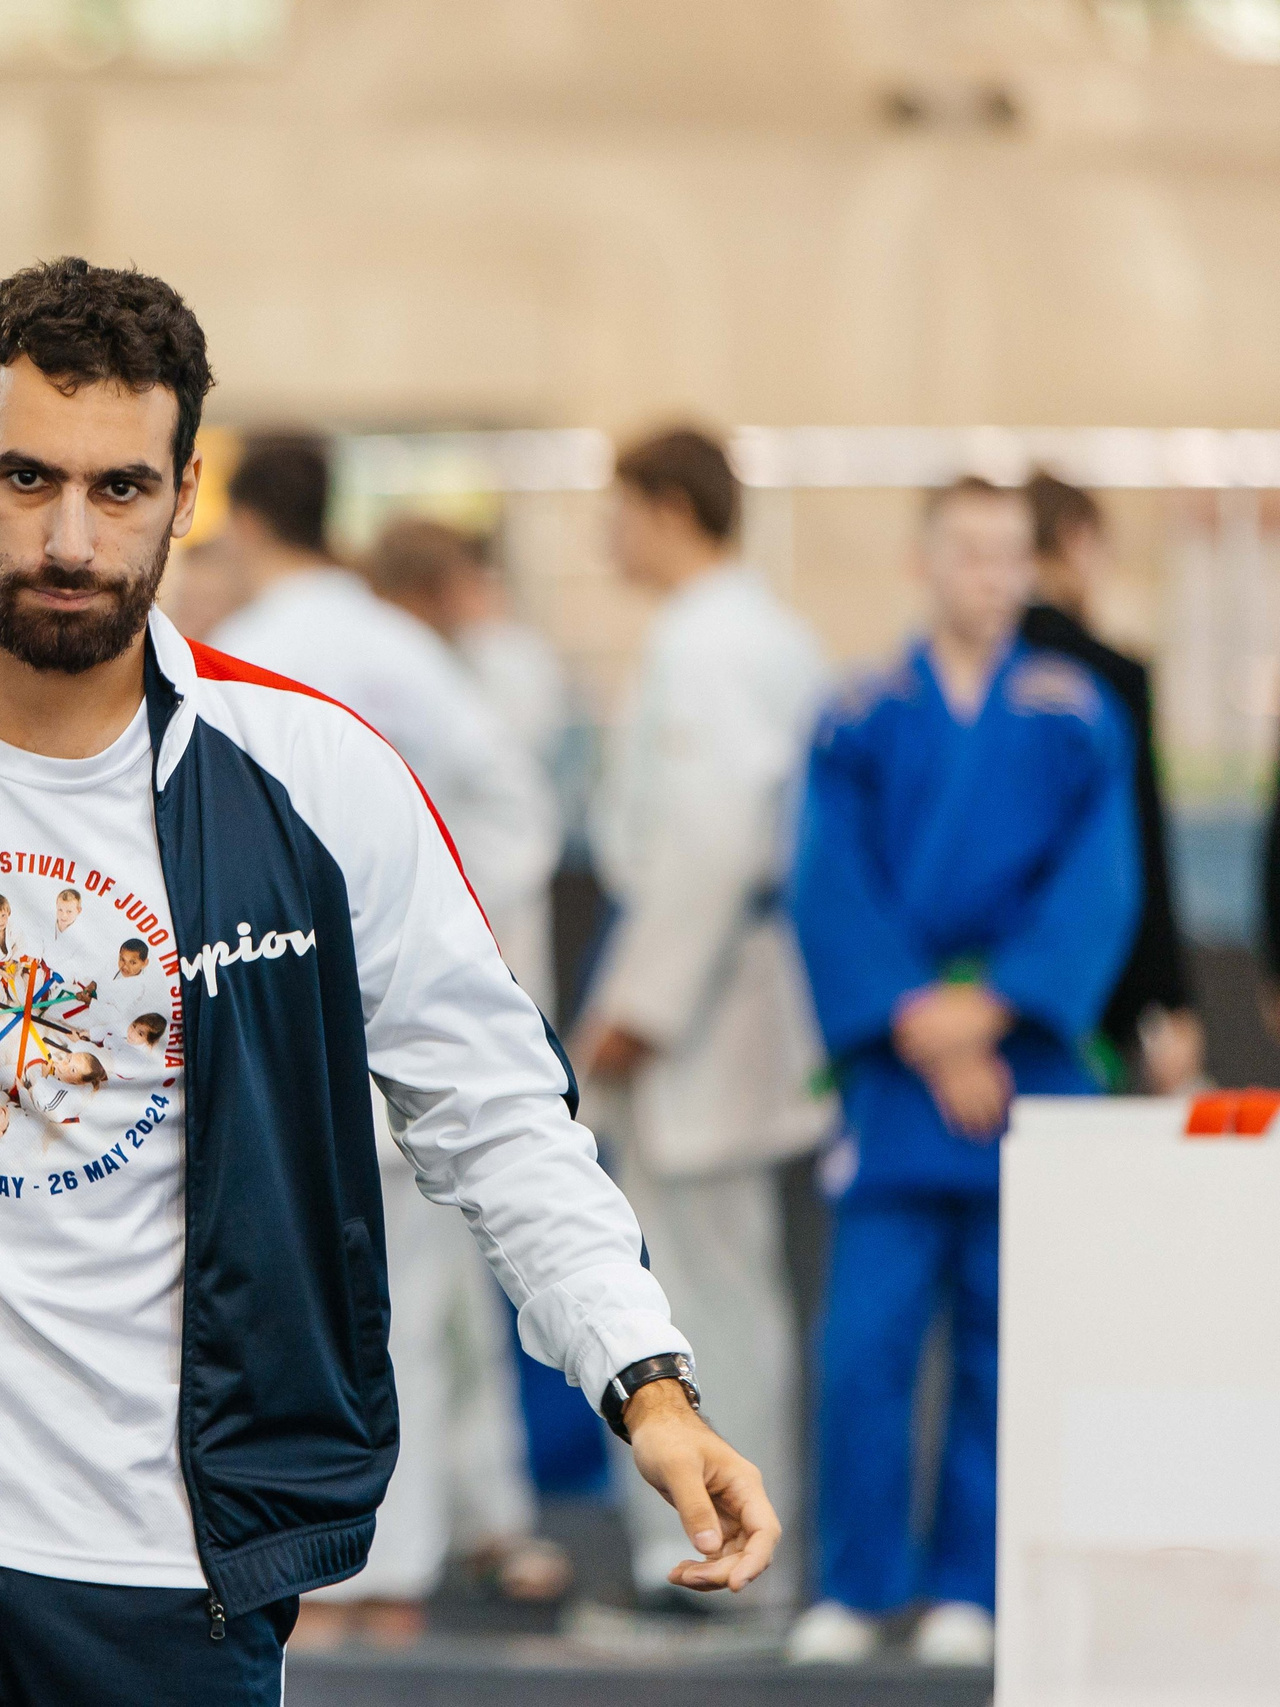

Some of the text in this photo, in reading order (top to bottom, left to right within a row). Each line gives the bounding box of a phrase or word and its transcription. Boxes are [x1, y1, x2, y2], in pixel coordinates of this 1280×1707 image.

[84, 869, 116, 897] OF
[114, 892, 169, 947] JUDO
[158, 949, 180, 977] IN
[48, 1170, 78, 1195] 26
[83, 1142, 129, 1183] MAY
[125, 1093, 170, 1149] 2024
